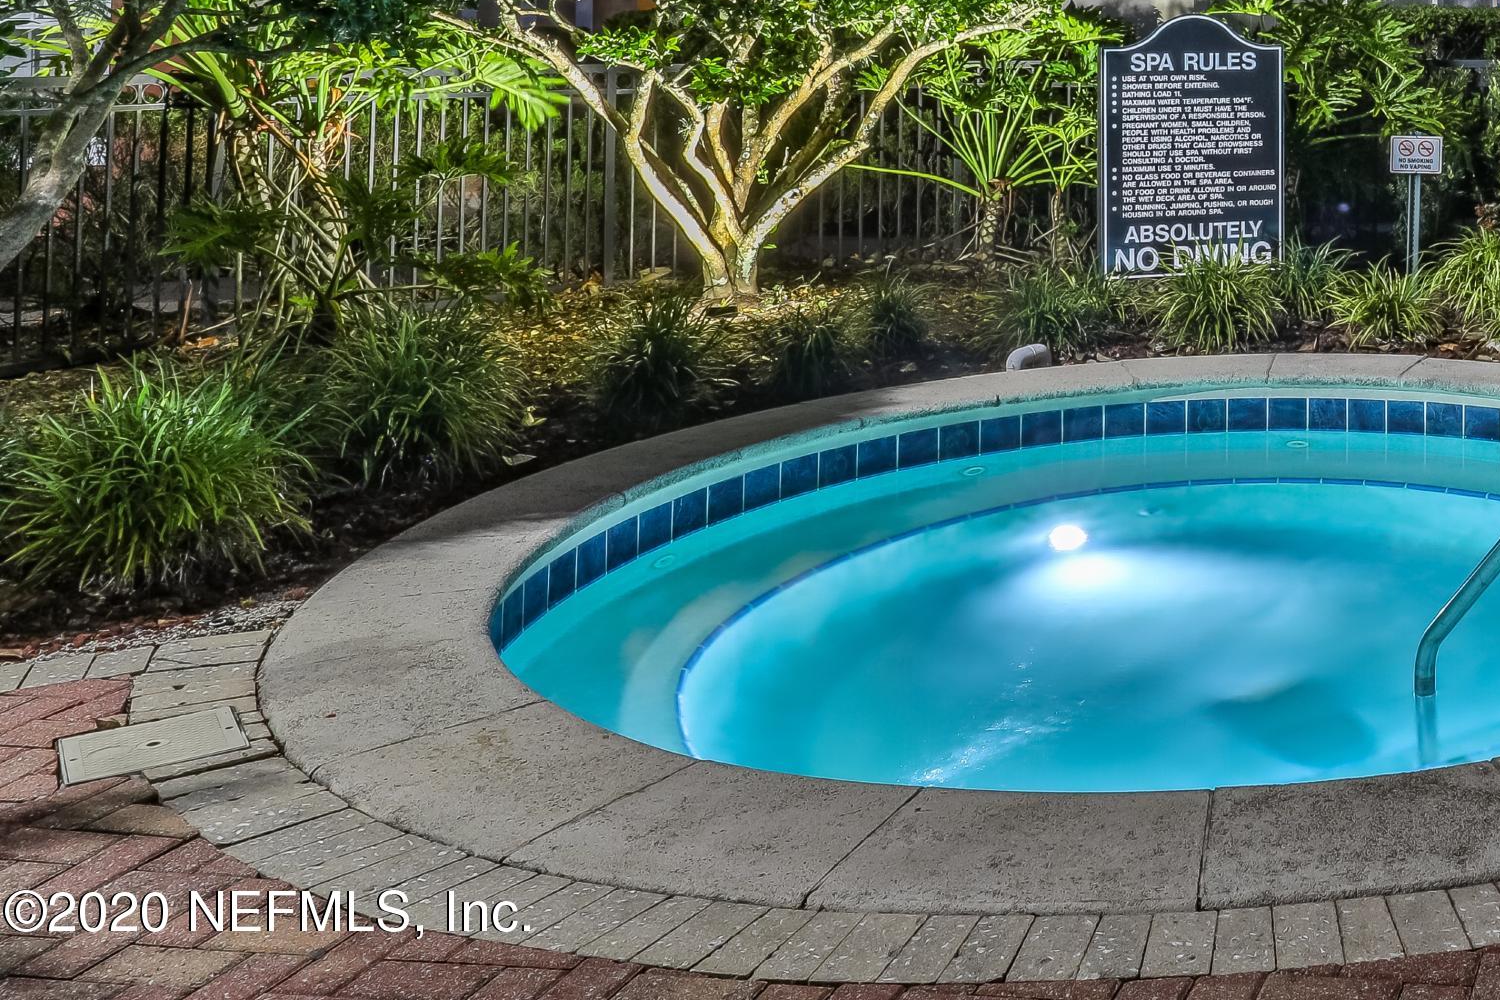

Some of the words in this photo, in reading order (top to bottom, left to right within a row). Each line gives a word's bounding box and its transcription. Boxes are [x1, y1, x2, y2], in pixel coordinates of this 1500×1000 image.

[1130, 53, 1174, 72] SPA
[1184, 52, 1257, 71] RULES
[1218, 140, 1263, 148] DROWSINESS
[1233, 169, 1275, 177] CONTAINERS
[1124, 220, 1263, 244] ABSOLUTELY
[1115, 247, 1159, 272] NO
